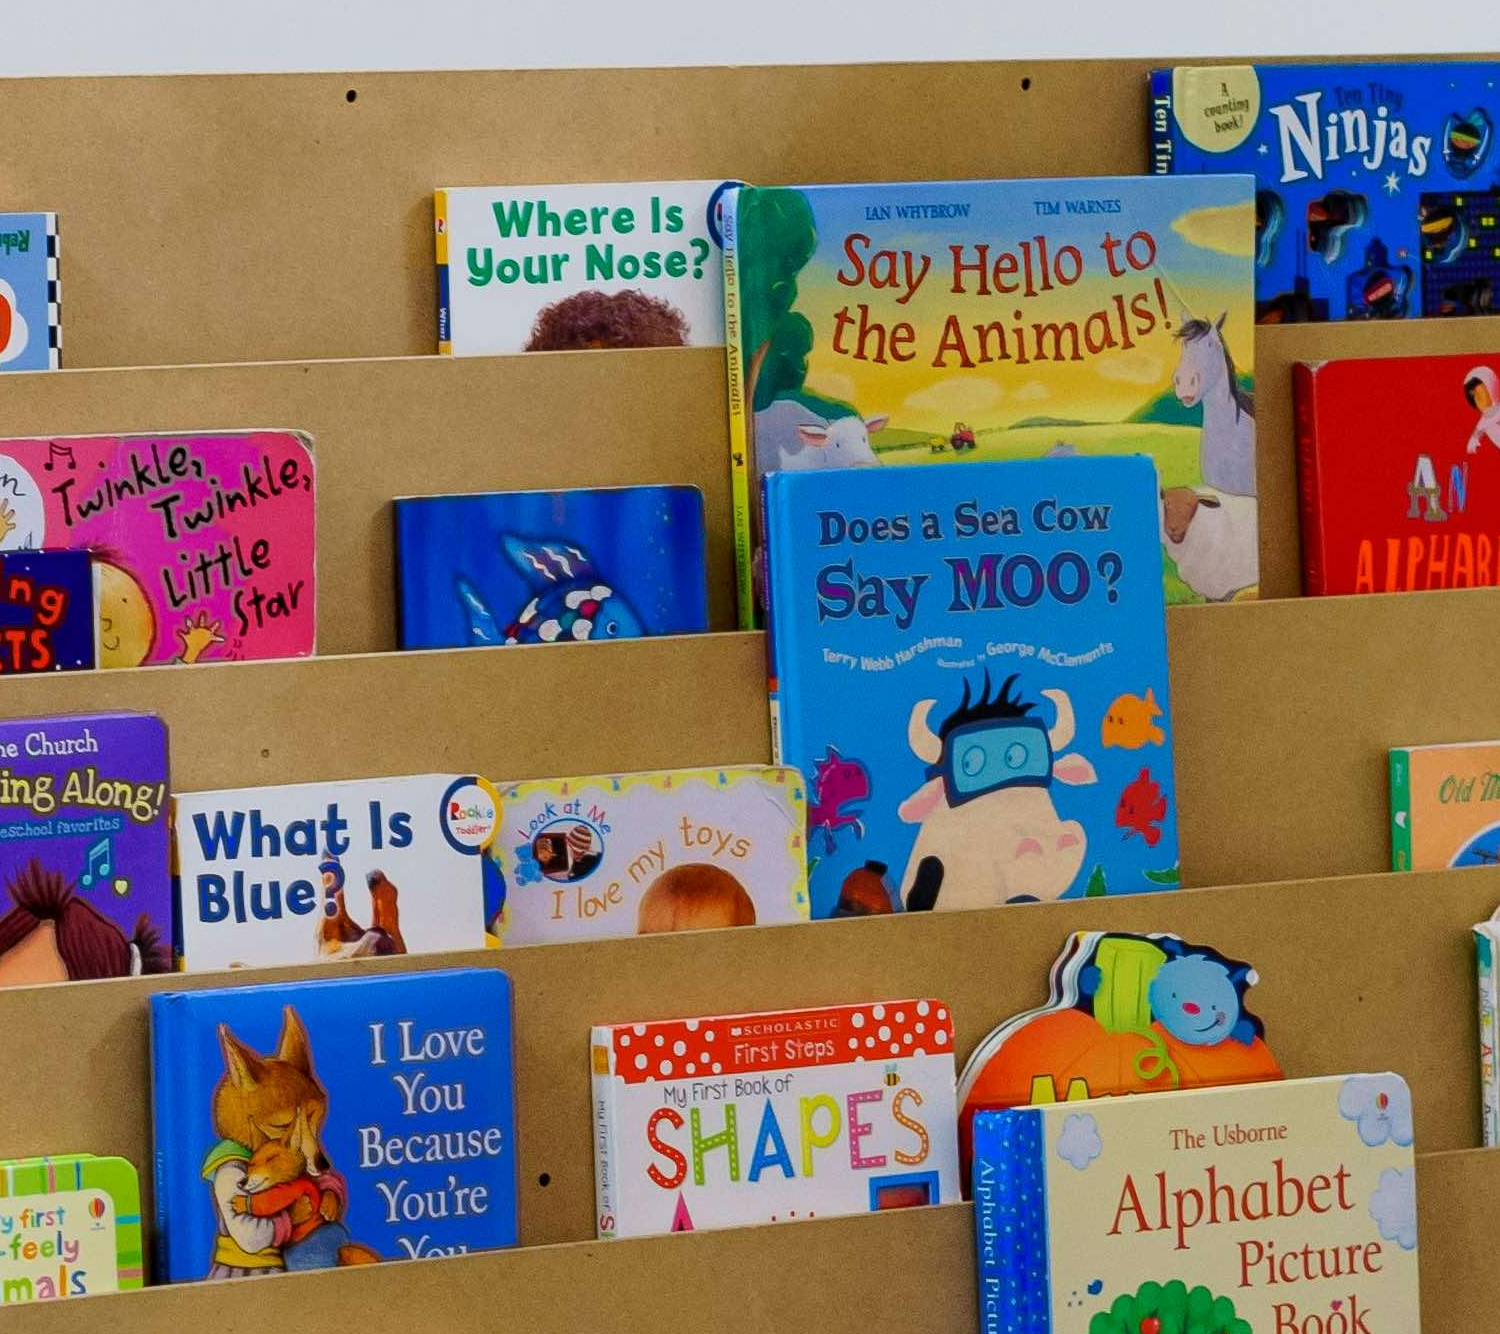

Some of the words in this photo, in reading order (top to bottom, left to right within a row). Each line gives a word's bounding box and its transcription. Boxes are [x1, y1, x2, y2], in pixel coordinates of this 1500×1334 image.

[1204, 98, 1250, 117] counting
[1221, 82, 1230, 97] A
[1154, 95, 1171, 133] Ten
[1268, 91, 1432, 184] Ninjas
[492, 199, 635, 238] Where
[649, 196, 684, 233] Is
[865, 204, 893, 221] IAN
[897, 202, 971, 220] WHYBROW
[1034, 200, 1060, 216] TIM
[1065, 198, 1122, 215] WARNES
[467, 247, 570, 287] Your
[585, 237, 710, 281] Nose?
[837, 233, 931, 305] Say
[949, 234, 1083, 297] Hello
[1101, 229, 1157, 279] to
[727, 293, 736, 308] to
[832, 304, 917, 365] the
[932, 277, 1173, 368] Animals!
[728, 314, 737, 337] the
[52, 443, 203, 526] Twinkle,
[151, 456, 312, 539] Twinkle,
[1406, 453, 1469, 522] AN
[817, 509, 911, 546] Does
[921, 511, 943, 540] a
[954, 498, 1022, 538] Sea
[1032, 499, 1112, 534] Cow
[161, 536, 270, 608] Little
[816, 556, 929, 630] Say
[944, 550, 1125, 613] MOO?
[233, 581, 305, 637] Star
[822, 647, 858, 669] Terry
[861, 655, 894, 671] Webb
[895, 636, 963, 666] Harshman
[985, 641, 1035, 657] George
[24, 728, 99, 757] Church
[61, 767, 166, 822] Along!
[1439, 774, 1474, 804] Old
[56, 818, 120, 836] favorites
[193, 802, 350, 862] What
[370, 800, 414, 850] Is
[517, 802, 559, 840] Look
[563, 798, 581, 816] at
[588, 805, 612, 835] Me
[550, 890, 564, 920] I
[576, 883, 624, 920] love
[626, 841, 666, 885] my
[679, 816, 752, 860] toys
[197, 861, 346, 923] Blue?
[369, 1022, 386, 1066] I
[398, 1020, 486, 1062] Love
[743, 1018, 838, 1036] SCHOLASTIC
[734, 1043, 780, 1065] First
[784, 1039, 835, 1063] Steps
[392, 1072, 466, 1115] You
[663, 1085, 688, 1109] My
[692, 1080, 729, 1101] First
[735, 1074, 772, 1096] Book
[774, 1073, 794, 1093] of
[358, 1125, 503, 1169] Because
[646, 1087, 930, 1189] SHAPES
[1170, 1128, 1206, 1151] The
[1212, 1122, 1289, 1148] Usborne
[19, 1207, 66, 1228] first
[375, 1175, 488, 1224] You're
[977, 1159, 997, 1266] Alphabet
[1106, 1158, 1356, 1251] Alphabet
[1237, 1238, 1384, 1288] Picture
